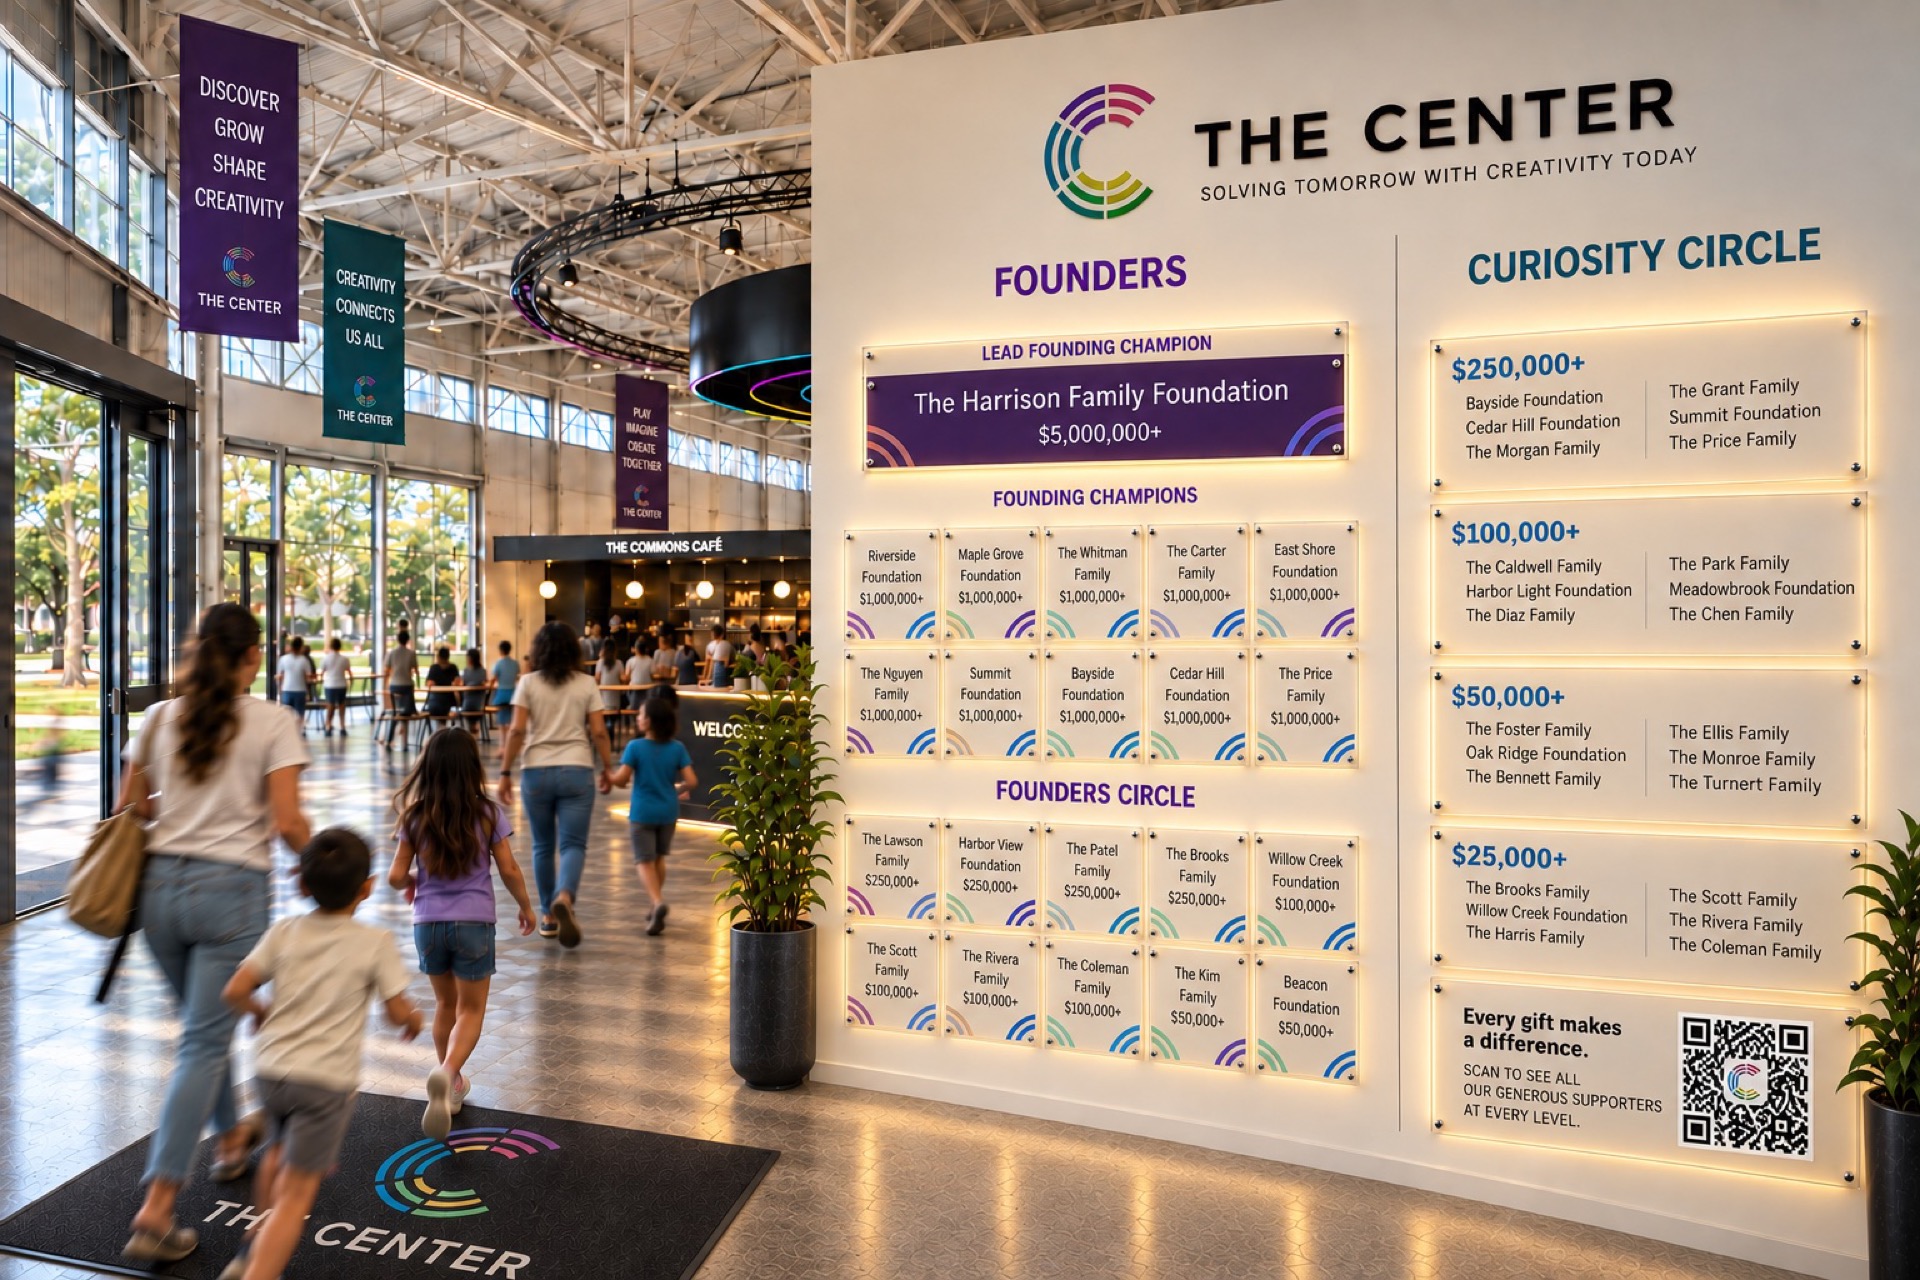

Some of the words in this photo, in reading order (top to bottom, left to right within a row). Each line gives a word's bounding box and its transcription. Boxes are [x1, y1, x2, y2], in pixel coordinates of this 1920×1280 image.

[200, 75, 279, 112] DISCOVER
[215, 117, 264, 144] GROW
[1194, 111, 1328, 167] THE
[1364, 78, 1674, 152] CENTER
[213, 153, 266, 180] SHARE
[1201, 180, 1285, 201] SOLVING
[1294, 170, 1415, 194] TOMORROW
[1424, 166, 1476, 184] WITH
[1487, 154, 1613, 179] CREATIVITY
[1622, 146, 1696, 168] TODAY
[195, 187, 284, 219] CREATIVITY
[1468, 238, 1665, 284] CURIOSITY
[1678, 227, 1820, 269] CIRCLE
[336, 269, 395, 294] CREATIVITY
[996, 255, 1186, 296] FOUNDERS
[198, 292, 224, 308] THE
[229, 296, 281, 314] CENTER
[336, 297, 395, 323] CONNECTS
[346, 328, 361, 345] US
[364, 332, 384, 349] ALL
[983, 344, 1023, 360] LEAD
[1029, 339, 1115, 358] FOUNDING
[1120, 335, 1211, 354] CHAMPION
[1452, 353, 1585, 383] $250,000+
[914, 392, 954, 414] The
[964, 388, 1060, 411] Harrison
[1070, 383, 1144, 411] Family
[1154, 378, 1288, 404] Foundation
[1669, 384, 1697, 398] The
[1702, 382, 1744, 396] Grant
[1750, 378, 1799, 396] Family
[1466, 394, 1519, 412] Bayside
[1524, 390, 1603, 407] Foundation
[337, 409, 355, 421] THE
[358, 412, 393, 426] CENTER
[1670, 407, 1728, 424] Summit
[1734, 404, 1821, 421] Foundation
[1466, 420, 1508, 434] Cedar
[1512, 417, 1534, 432] Hill
[1540, 414, 1620, 430] Foundation
[1039, 422, 1161, 446] $5,000,000+
[622, 457, 661, 471] TOGETHER
[994, 489, 1084, 506] FOUNDING
[1090, 486, 1198, 505] CHAMPIONS
[624, 507, 635, 516] THE
[1452, 520, 1580, 546] $100,000+
[606, 541, 628, 553] THE
[630, 540, 690, 553] COMMONS
[692, 536, 722, 551] CAFÉ
[1058, 546, 1077, 559] The
[1080, 546, 1127, 558] Whitman
[1274, 543, 1299, 555] East
[1302, 543, 1335, 555] Shore
[868, 549, 916, 561] Riverside
[1669, 556, 1696, 570] The
[1702, 556, 1735, 570] Park
[1740, 555, 1790, 573] Family
[862, 570, 921, 582] Foundation
[1075, 567, 1110, 583] Family
[1273, 564, 1337, 578] Foundation
[1466, 560, 1491, 574] The
[1496, 559, 1552, 574] Caldwell
[1558, 558, 1602, 575] Family
[1060, 590, 1125, 604] $1,000,000+
[1270, 587, 1340, 602] $1,000,000+
[1467, 584, 1513, 598] Harbor
[1517, 584, 1551, 601] Light
[1556, 583, 1632, 596] Foundation
[1670, 580, 1770, 596] Meadowbrook
[1774, 580, 1854, 595] Foundation
[860, 592, 923, 606] $1,000,000+
[970, 667, 1011, 679] Summit
[1170, 667, 1203, 679] Cedar
[1206, 667, 1224, 679] Hill
[961, 687, 1021, 700] Foundation
[1166, 688, 1229, 701] Foundation
[1452, 684, 1564, 710] $50,000+
[959, 709, 1022, 724] $1,000,000+
[1164, 710, 1231, 725] $1,000,000+
[1466, 721, 1491, 735] The
[1496, 722, 1540, 736] Foster
[1545, 722, 1591, 740] Family
[1669, 724, 1697, 739] The
[1703, 725, 1733, 739] Ellis
[1739, 725, 1789, 744] Family
[1466, 745, 1493, 759] Oak
[1498, 745, 1538, 764] Ridge
[1544, 746, 1626, 761] Foundation
[997, 780, 1110, 804] FOUNDERS
[1118, 784, 1195, 807] CIRCLE
[1669, 774, 1698, 789] The
[1703, 775, 1763, 791] Turnert
[1769, 777, 1821, 796] Family
[862, 832, 881, 845] The
[884, 834, 923, 846] Lawson
[1066, 842, 1087, 855] The
[1090, 843, 1118, 856] Patel
[1452, 842, 1567, 870] $25,000+
[876, 853, 909, 870] Family
[1268, 852, 1306, 865] Willow
[1309, 854, 1343, 867] Creek
[865, 874, 919, 888] $250,000+
[1074, 863, 1111, 880] Family
[1064, 884, 1121, 899] $250,000+
[1273, 874, 1339, 890] Foundation
[1466, 880, 1491, 894] The
[1496, 882, 1541, 896] Brooks
[1546, 884, 1590, 902] Family
[1275, 896, 1336, 913] $100,000+
[1669, 888, 1696, 903] The
[1702, 889, 1742, 905] Scott
[1748, 891, 1797, 910] Family
[1466, 903, 1508, 917] Willow
[1512, 905, 1549, 919] Creek
[1554, 907, 1627, 924] Foundation
[962, 949, 982, 962] The
[986, 951, 1019, 965] Rivera
[1669, 936, 1696, 951] The
[1701, 938, 1766, 956] Coleman
[1772, 942, 1821, 963] Family
[974, 971, 1009, 989] Family
[1174, 966, 1195, 980] The
[1199, 968, 1220, 981] Kim
[963, 991, 1018, 1007] $100,000+
[1180, 988, 1217, 1007] Family
[1171, 1010, 1224, 1027] $50,000+
[1464, 1007, 1515, 1031] Every
[1521, 1012, 1554, 1033] gift
[1560, 1016, 1621, 1035] makes
[1464, 1035, 1474, 1047] a
[1480, 1031, 1588, 1058] difference.
[1464, 1063, 1499, 1078] SCAN
[1504, 1067, 1521, 1080] TO
[1526, 1069, 1551, 1083] SEE
[1556, 1072, 1580, 1085] ALL
[1464, 1083, 1491, 1096] OUR
[1496, 1086, 1568, 1104] GENEROUS
[1572, 1093, 1662, 1112] SUPPORTERS
[1464, 1103, 1480, 1116] AT
[1486, 1105, 1529, 1121] EVERY
[1534, 1111, 1580, 1127] LEVEL.
[202, 1199, 311, 1233] TH
[313, 1221, 531, 1280] CENTER
